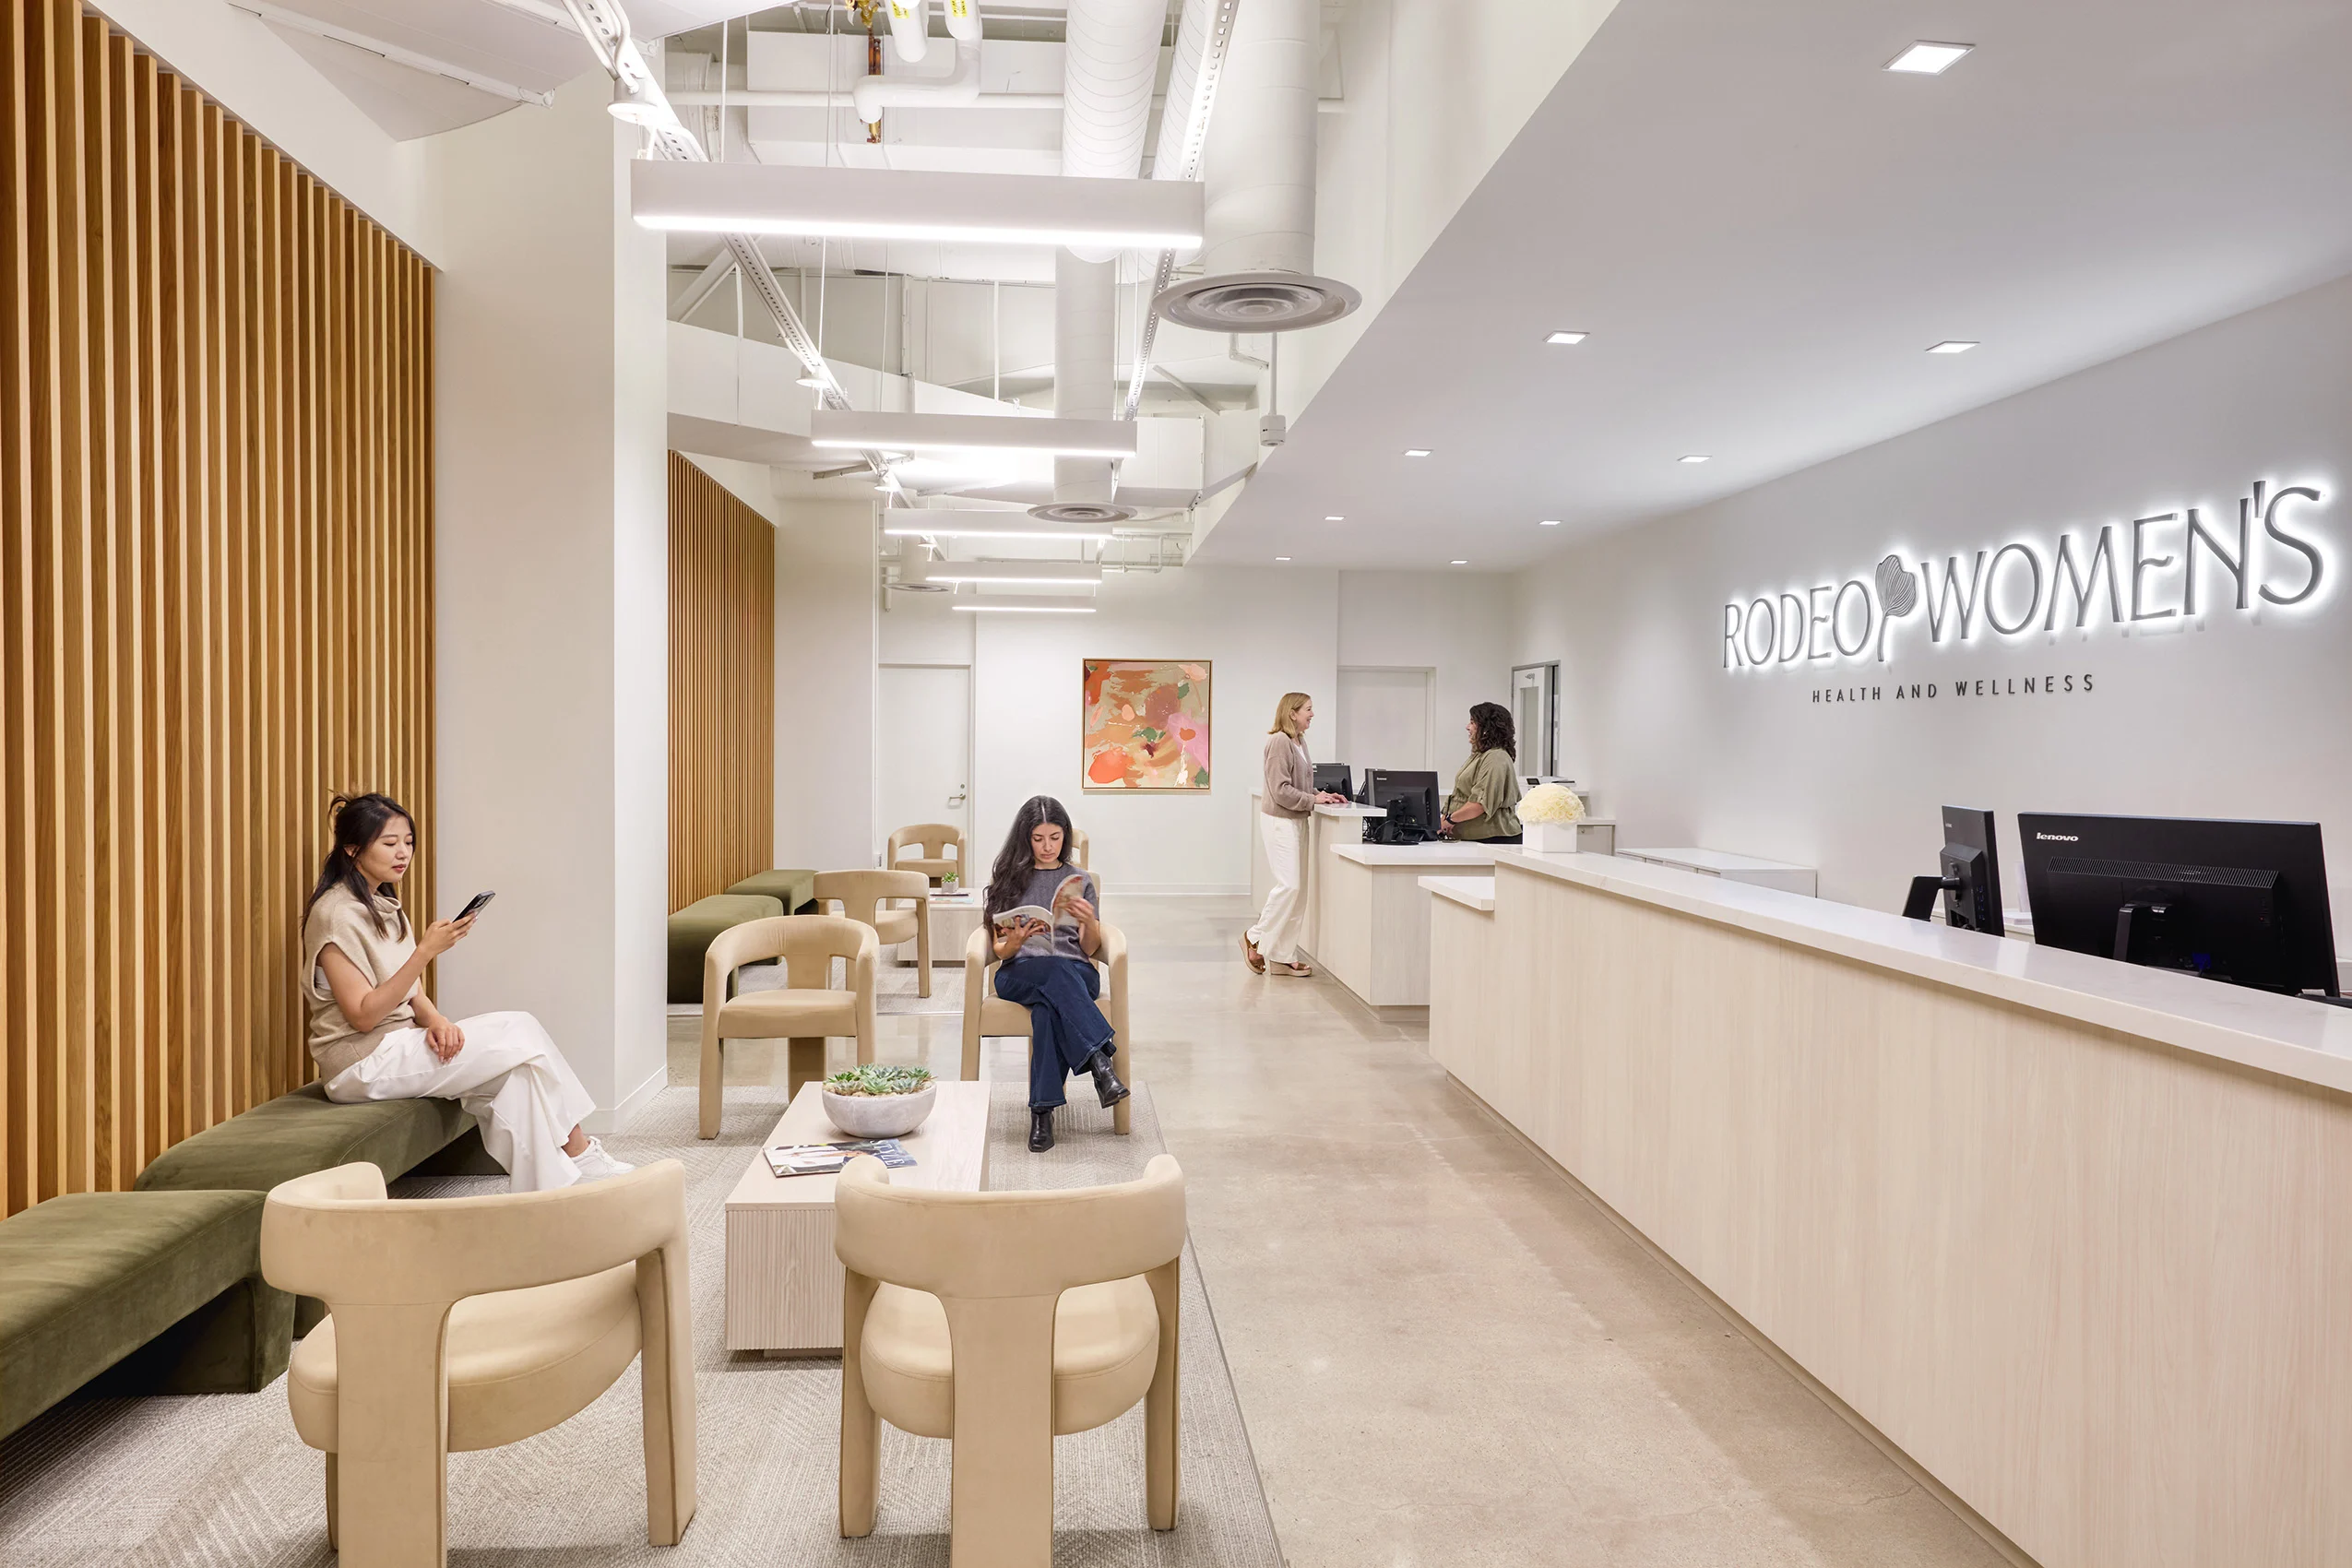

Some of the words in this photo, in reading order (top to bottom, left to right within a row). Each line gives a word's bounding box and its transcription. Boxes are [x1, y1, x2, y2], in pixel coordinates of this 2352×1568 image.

[1723, 579, 1872, 669] RODEO
[1920, 480, 2324, 643] WOMEN'S
[1812, 686, 1882, 703] HEALTH
[1895, 683, 1938, 699] AND
[1954, 673, 2095, 696] WELLNESS
[2036, 832, 2079, 842] lenovo
